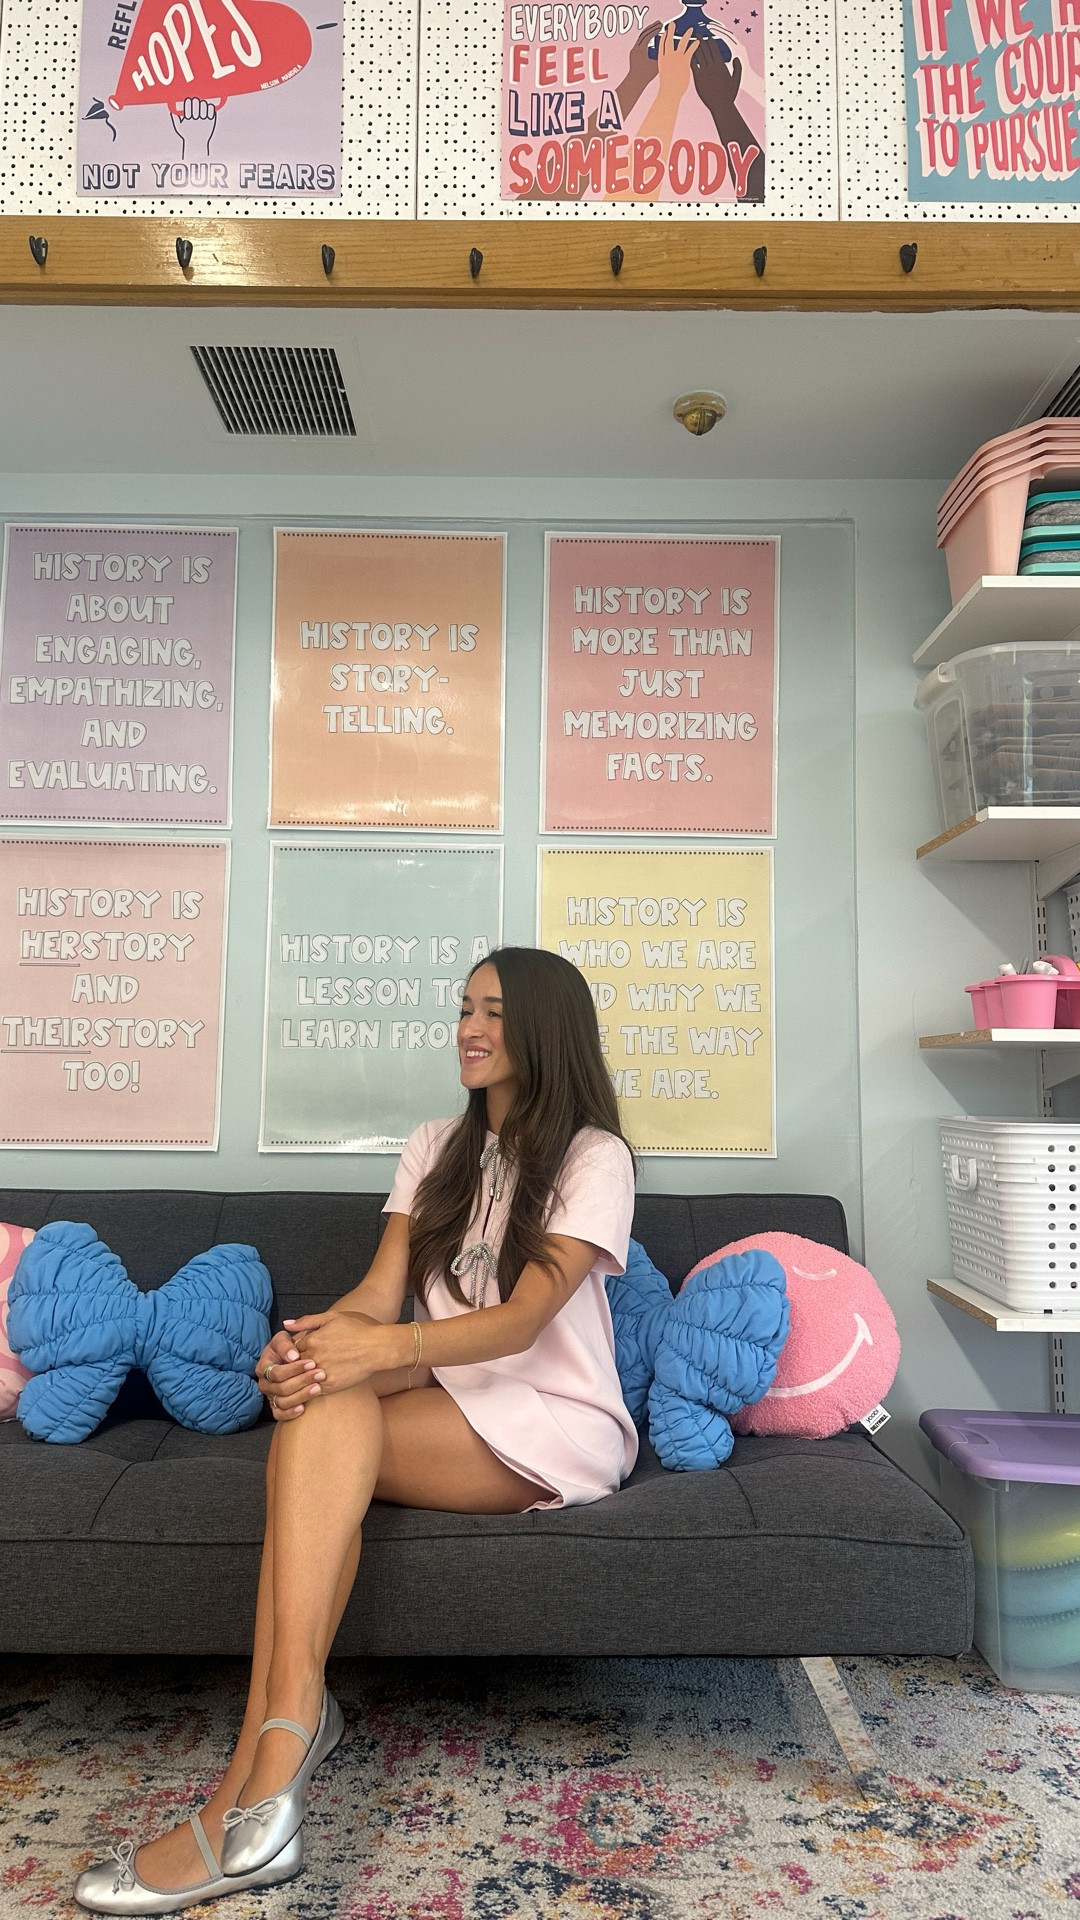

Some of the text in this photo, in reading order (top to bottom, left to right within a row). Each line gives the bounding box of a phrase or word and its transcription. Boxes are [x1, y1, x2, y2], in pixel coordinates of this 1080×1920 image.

[107, 1, 137, 50] REFL
[510, 4, 650, 42] EVERYBODY
[911, 0, 953, 60] IF
[131, 0, 262, 91] HOPES
[509, 45, 608, 88] FEEL
[912, 57, 986, 123] THE
[508, 89, 622, 137] LIKE A
[915, 101, 1080, 182] TO PURSUE
[82, 163, 336, 190] NOT YOUR FEARS
[509, 135, 759, 196] SOMEBODY
[33, 552, 213, 584] HISTORY IS
[66, 594, 174, 624] ABOUT
[573, 586, 752, 615] HISTORY IS
[36, 635, 201, 669] ENGAGING,
[301, 621, 480, 652] HISTORY IS
[572, 627, 753, 656] MORE THAN
[329, 663, 449, 693] STORY-
[618, 669, 704, 698] JUST
[9, 676, 223, 712] EMPATHIZING,
[81, 719, 147, 748] AND
[323, 705, 454, 735] TELLING.
[563, 710, 758, 741] MEMORIZING
[9, 760, 217, 794] EVALUATING.
[606, 753, 713, 782] FACTS.
[18, 887, 204, 919] HISTORY IS
[567, 897, 747, 927] HISTORY IS
[21, 930, 194, 962] HERSTORY
[280, 934, 490, 964] HISTORY IS A
[559, 939, 756, 970] WHO WE ARE
[72, 974, 139, 1004] AND
[297, 976, 421, 1006] LESSON
[628, 983, 704, 1012] WHY
[715, 984, 761, 1012] WE
[2, 1016, 205, 1048] THEIRSTORY
[282, 1019, 381, 1049] LEARN
[620, 1025, 678, 1055] THE
[689, 1026, 763, 1056] WAY
[63, 1060, 140, 1093] TOO!
[652, 1069, 719, 1099] ARE.
